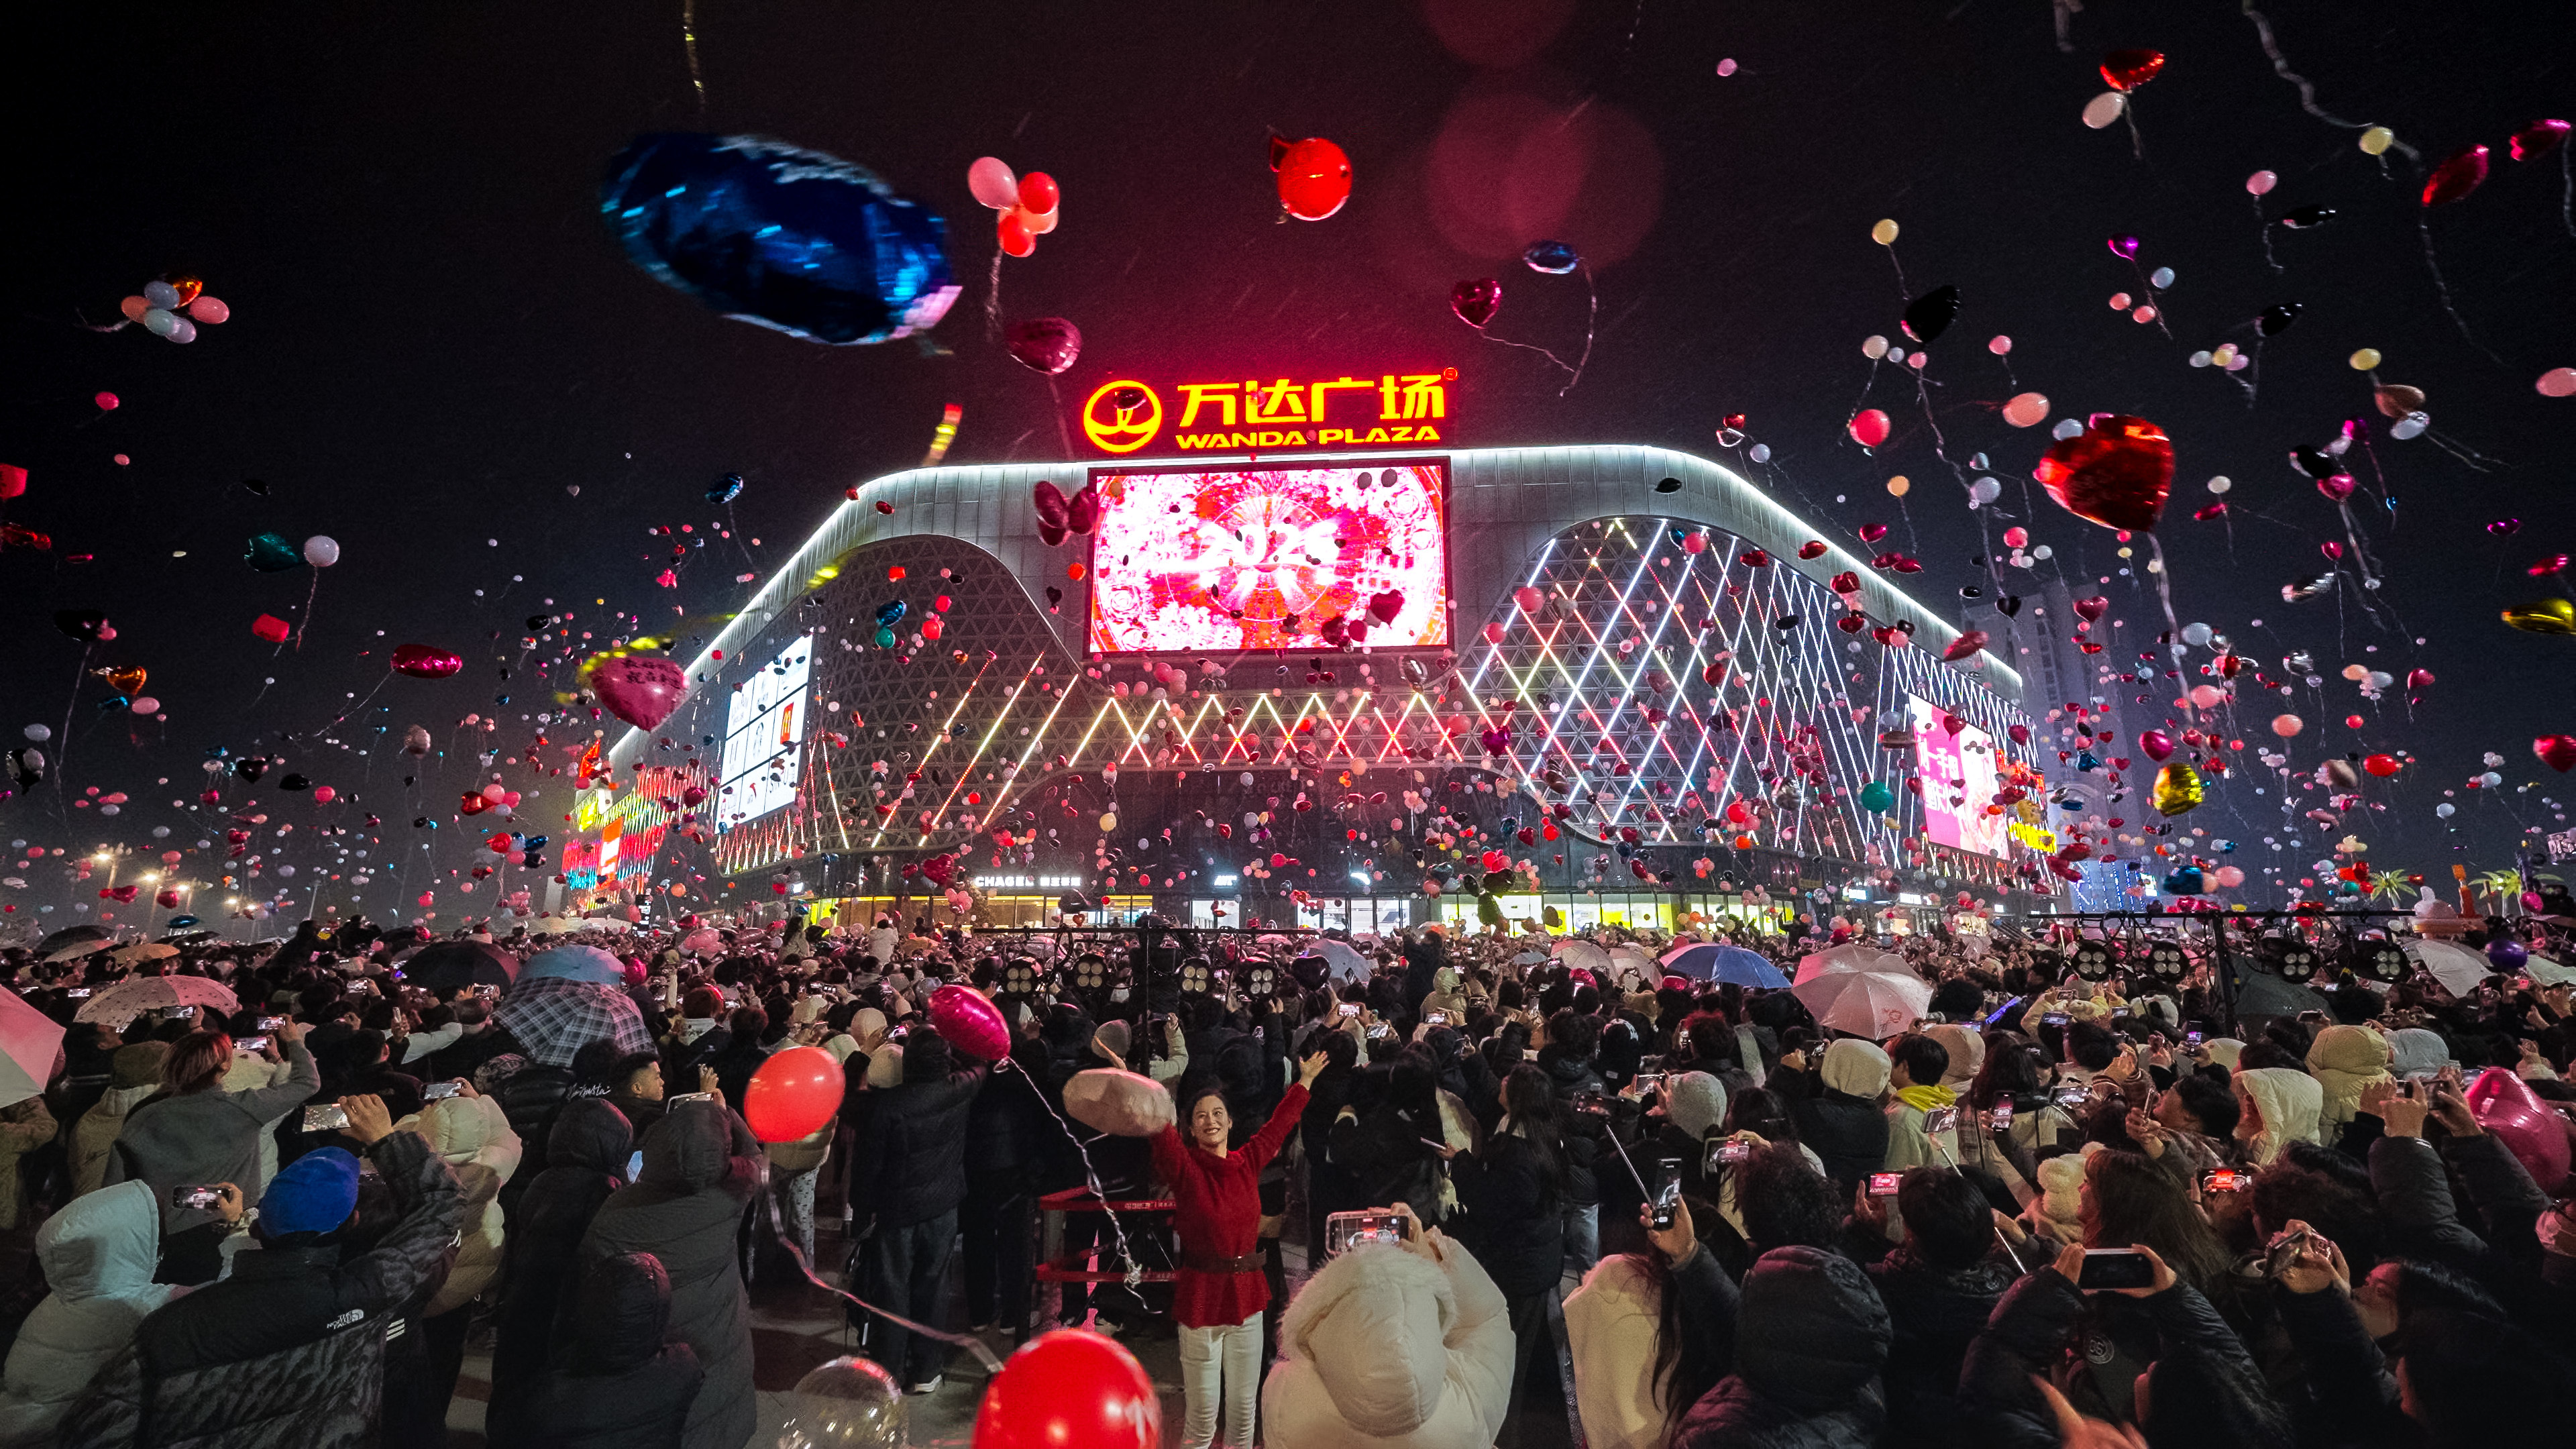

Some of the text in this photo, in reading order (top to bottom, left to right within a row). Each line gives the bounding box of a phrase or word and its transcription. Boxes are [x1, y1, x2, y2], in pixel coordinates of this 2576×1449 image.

[1178, 374, 1444, 427] 万达广场
[1175, 425, 1441, 449] WANDA PLAZA
